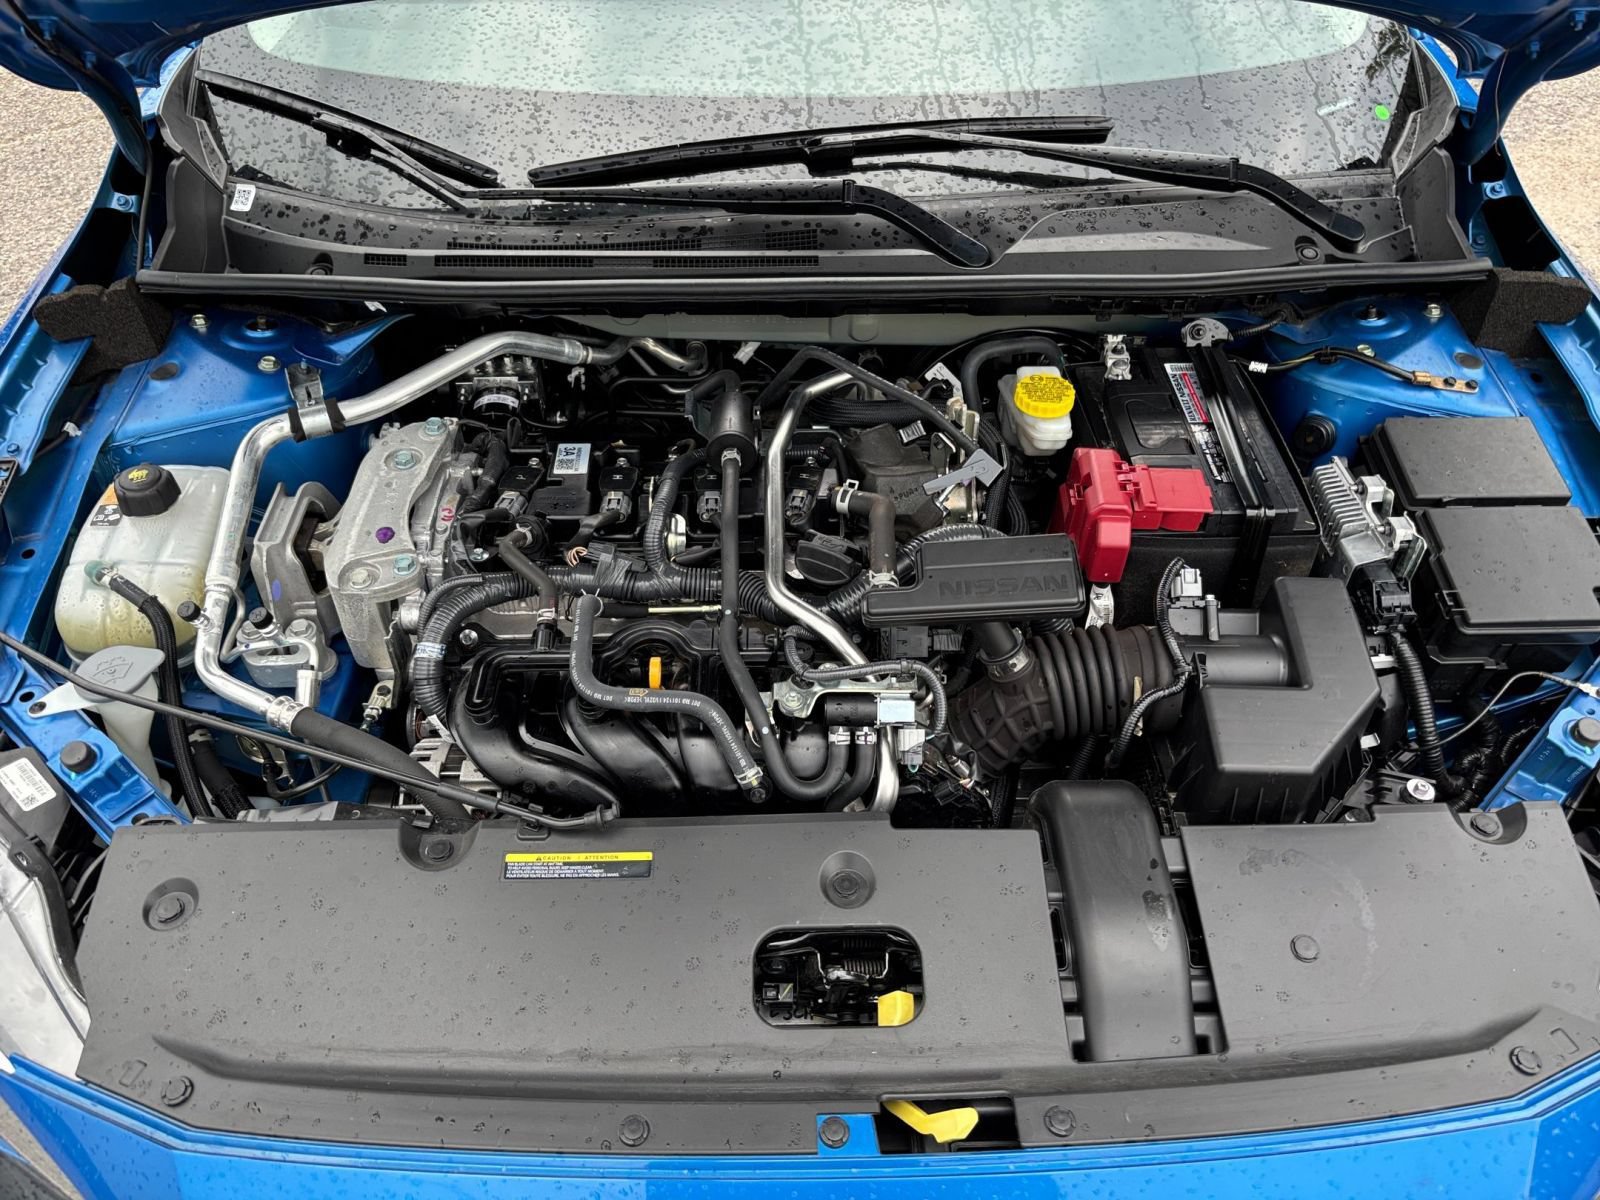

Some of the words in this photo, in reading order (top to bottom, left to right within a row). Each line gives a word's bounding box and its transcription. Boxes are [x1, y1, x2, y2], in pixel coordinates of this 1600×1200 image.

[1170, 374, 1186, 398] NISSAN
[563, 447, 576, 457] 3A
[938, 574, 1068, 596] NISSAN
